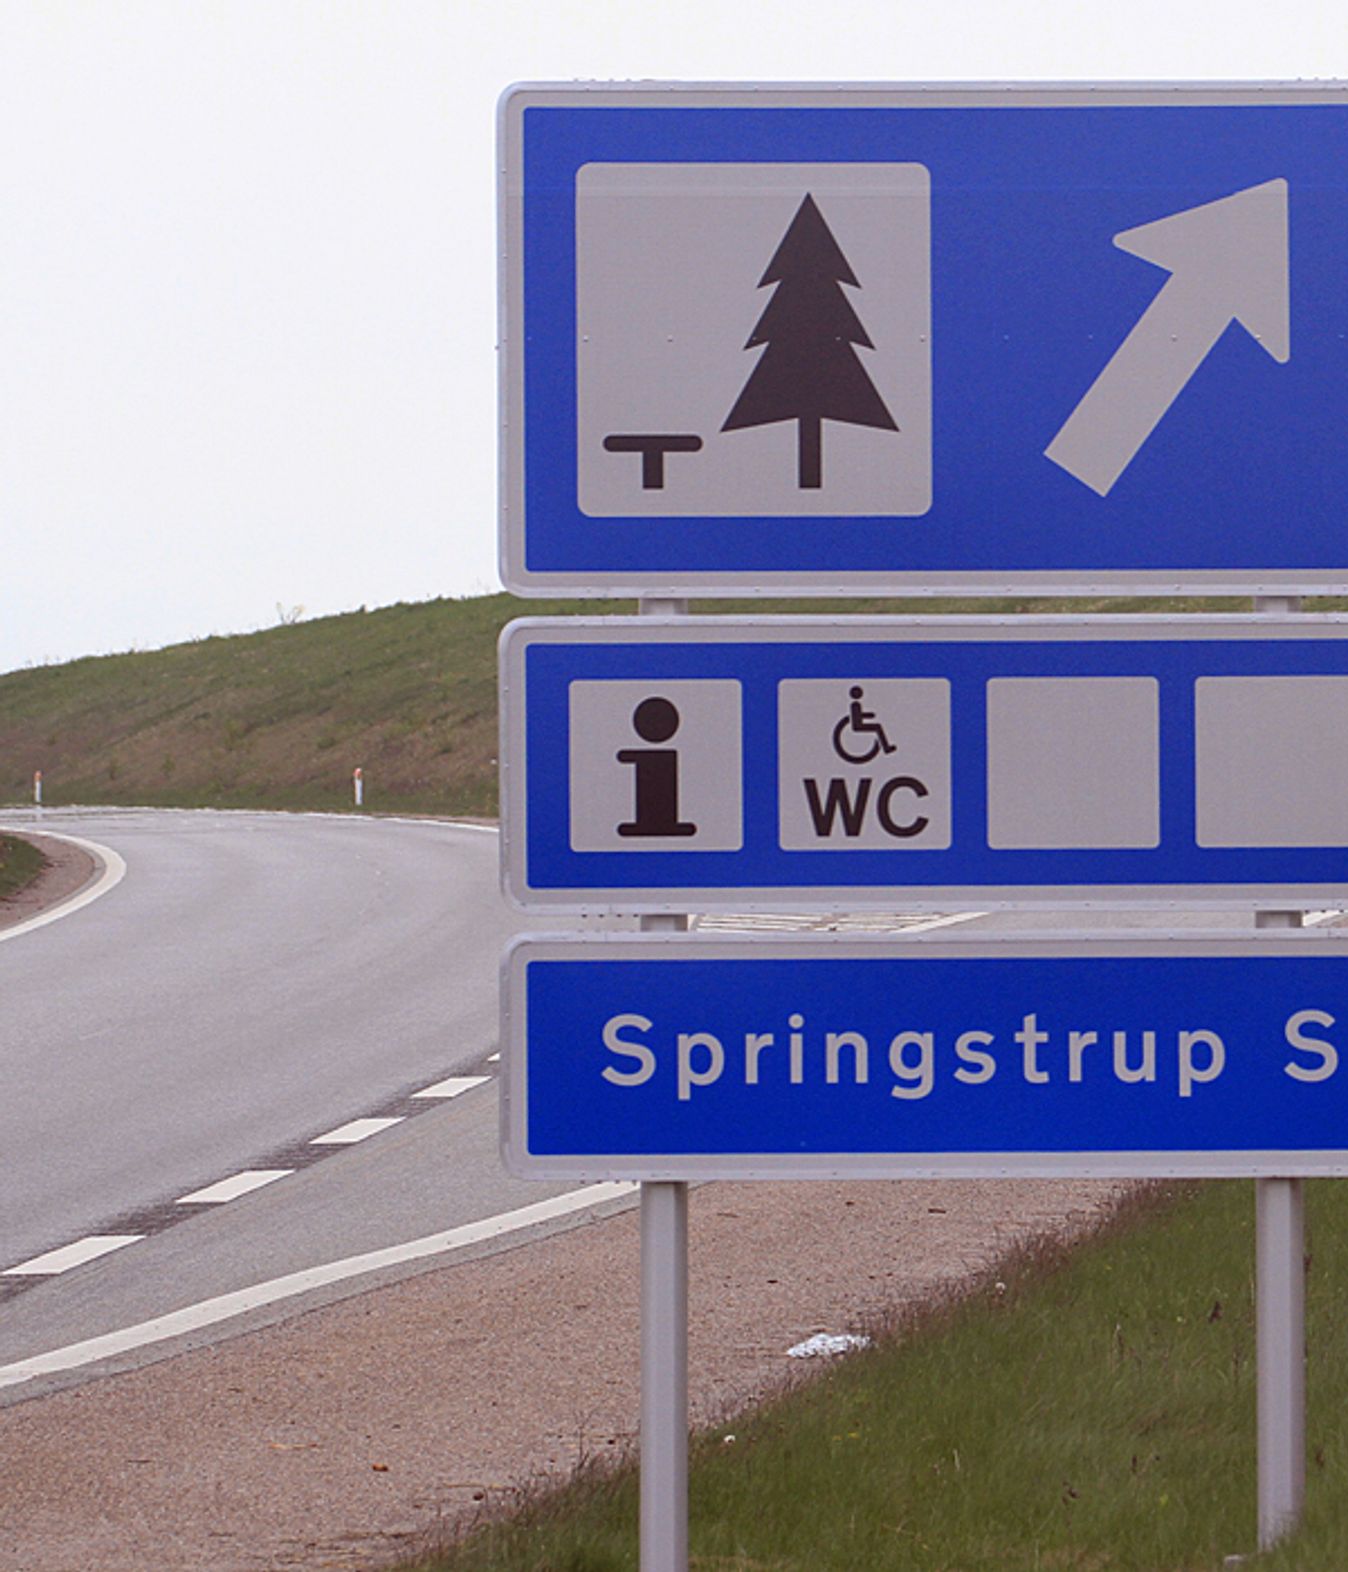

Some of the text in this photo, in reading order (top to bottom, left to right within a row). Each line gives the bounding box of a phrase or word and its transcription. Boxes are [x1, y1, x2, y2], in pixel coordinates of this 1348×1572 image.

[803, 776, 930, 838] WC
[602, 1010, 1338, 1100] Springstrup S
